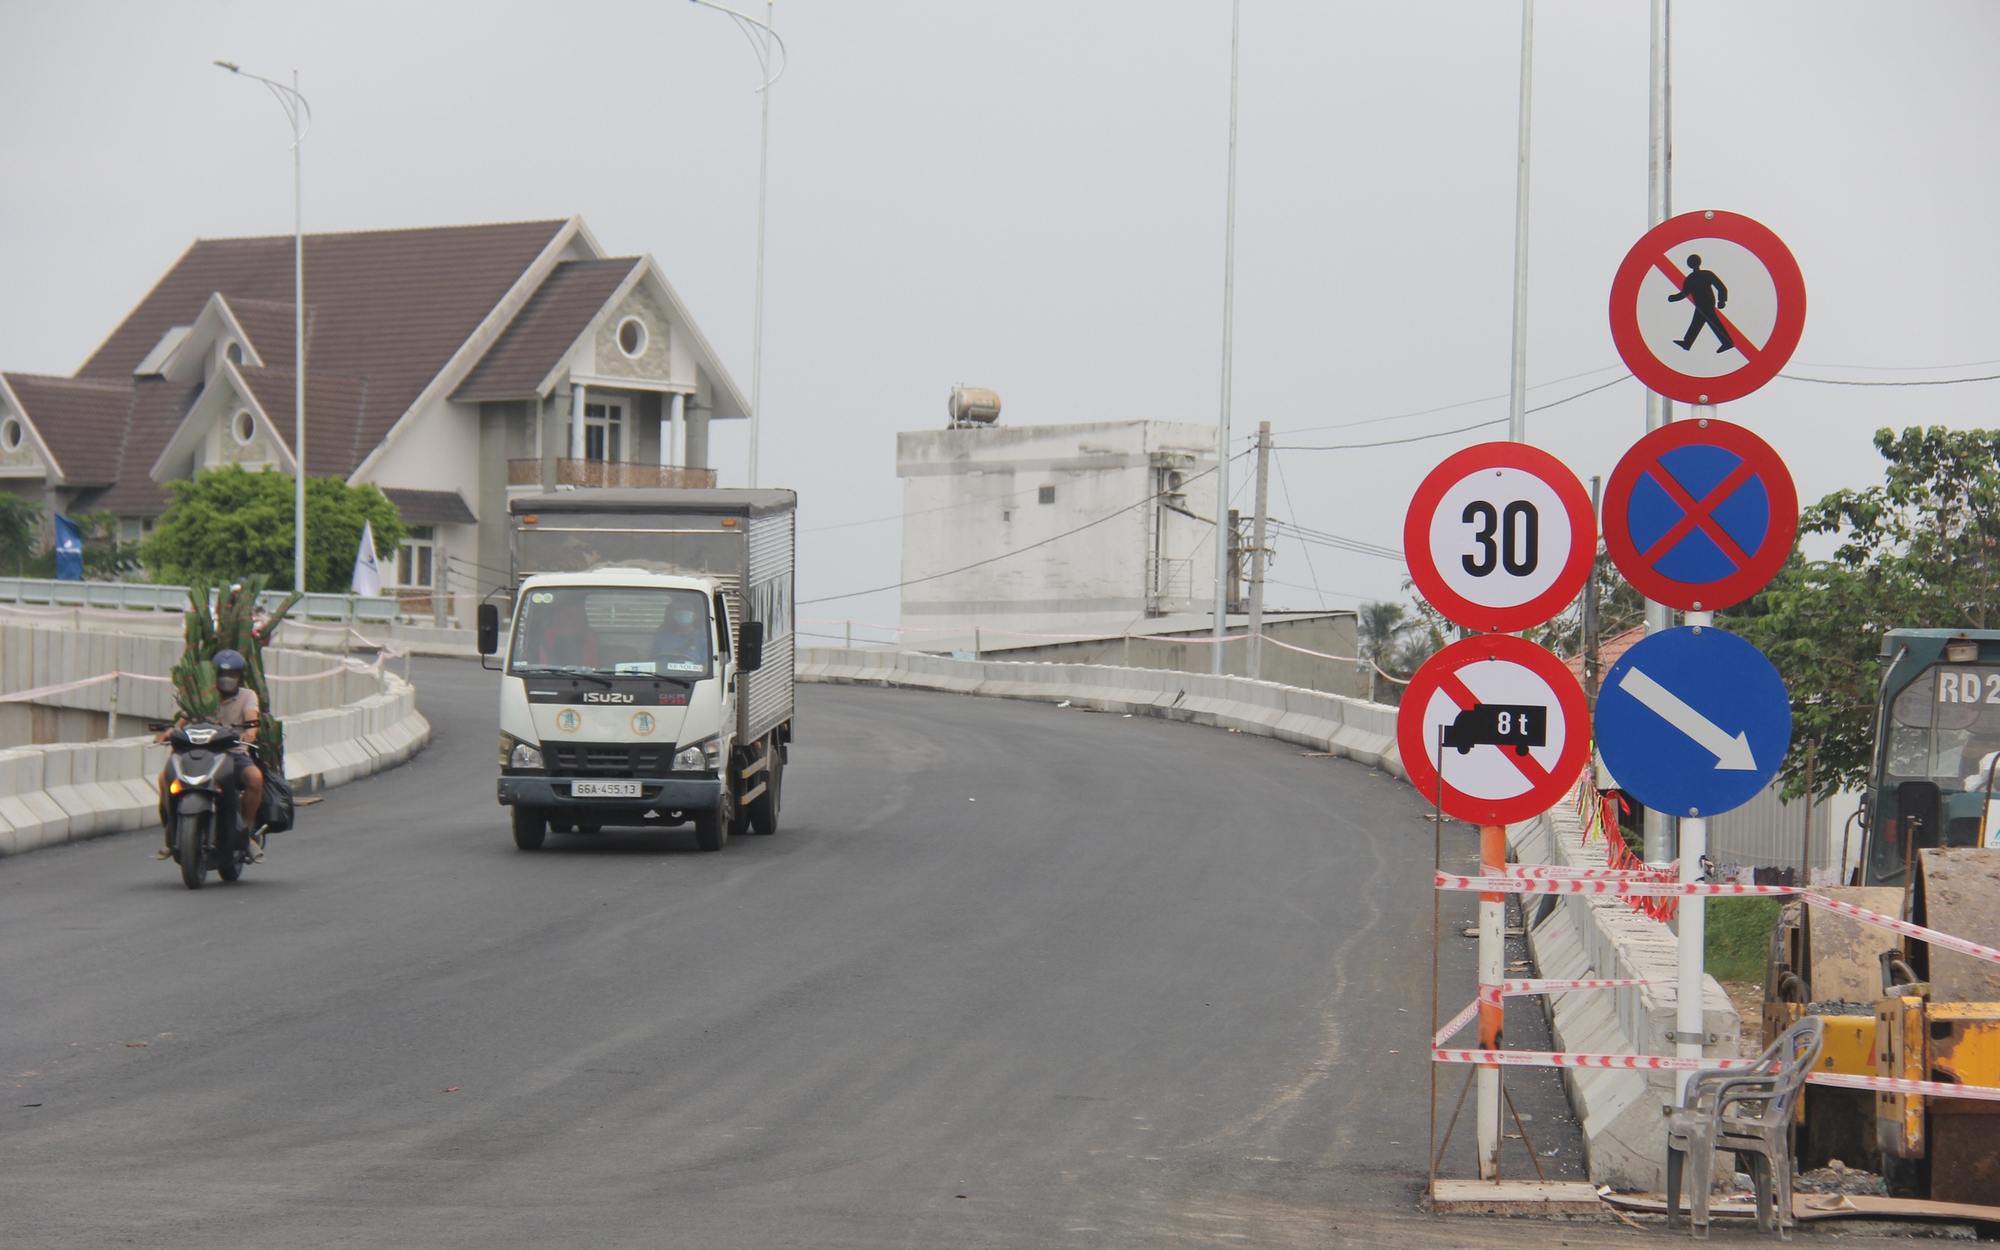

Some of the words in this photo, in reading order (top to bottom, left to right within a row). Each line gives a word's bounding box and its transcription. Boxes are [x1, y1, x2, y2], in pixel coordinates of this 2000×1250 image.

[1462, 500, 1539, 577] 30
[583, 692, 634, 703] ISUZU
[1498, 711, 1511, 735] 8
[1518, 713, 1528, 736] t
[577, 784, 636, 795] 66A-455.13
